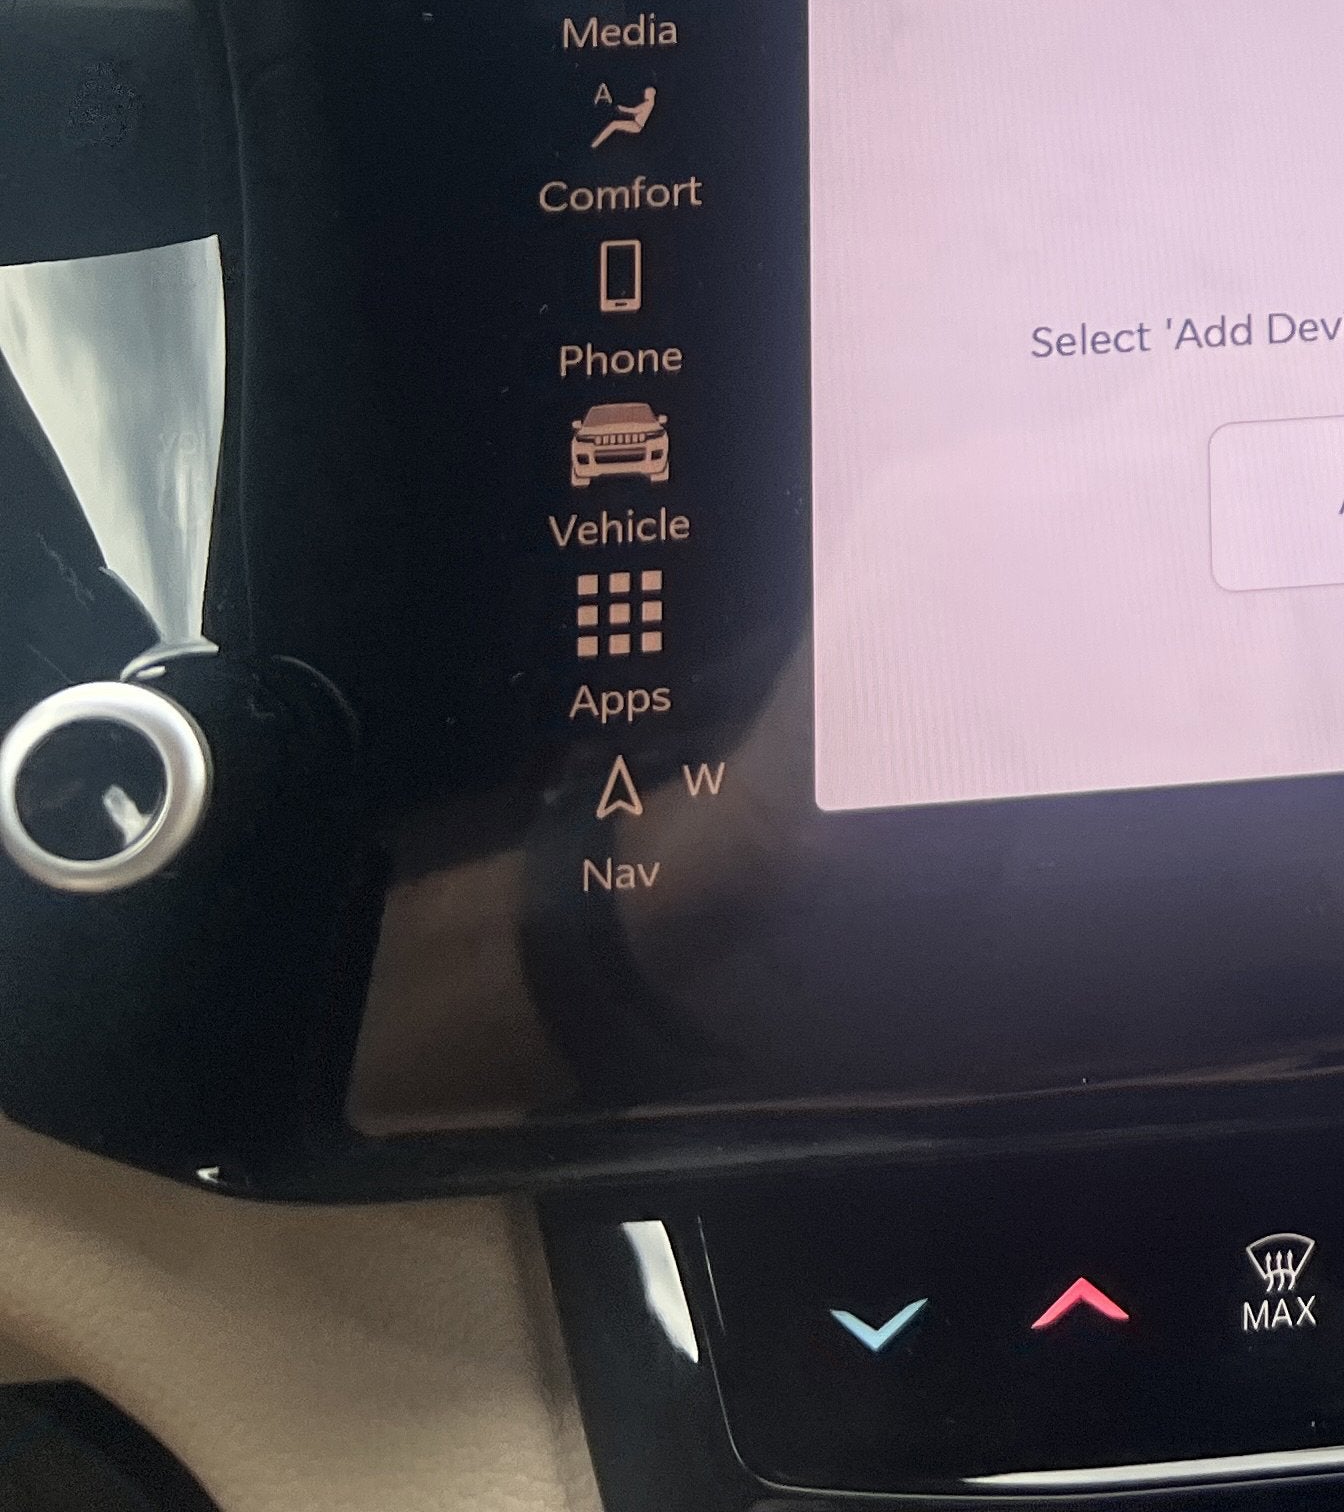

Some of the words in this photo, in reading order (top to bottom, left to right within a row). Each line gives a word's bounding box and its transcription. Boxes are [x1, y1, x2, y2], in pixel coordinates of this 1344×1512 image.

[562, 16, 679, 49] Media
[539, 175, 702, 213] Comfort
[1031, 322, 1152, 358] Select
[1165, 315, 1253, 351] 'Add
[559, 343, 683, 377] Phone
[549, 507, 692, 547] Vehicle
[569, 685, 672, 724] Apps
[682, 762, 726, 797] W
[582, 858, 661, 892] Nav
[1242, 1297, 1317, 1332] MAX
